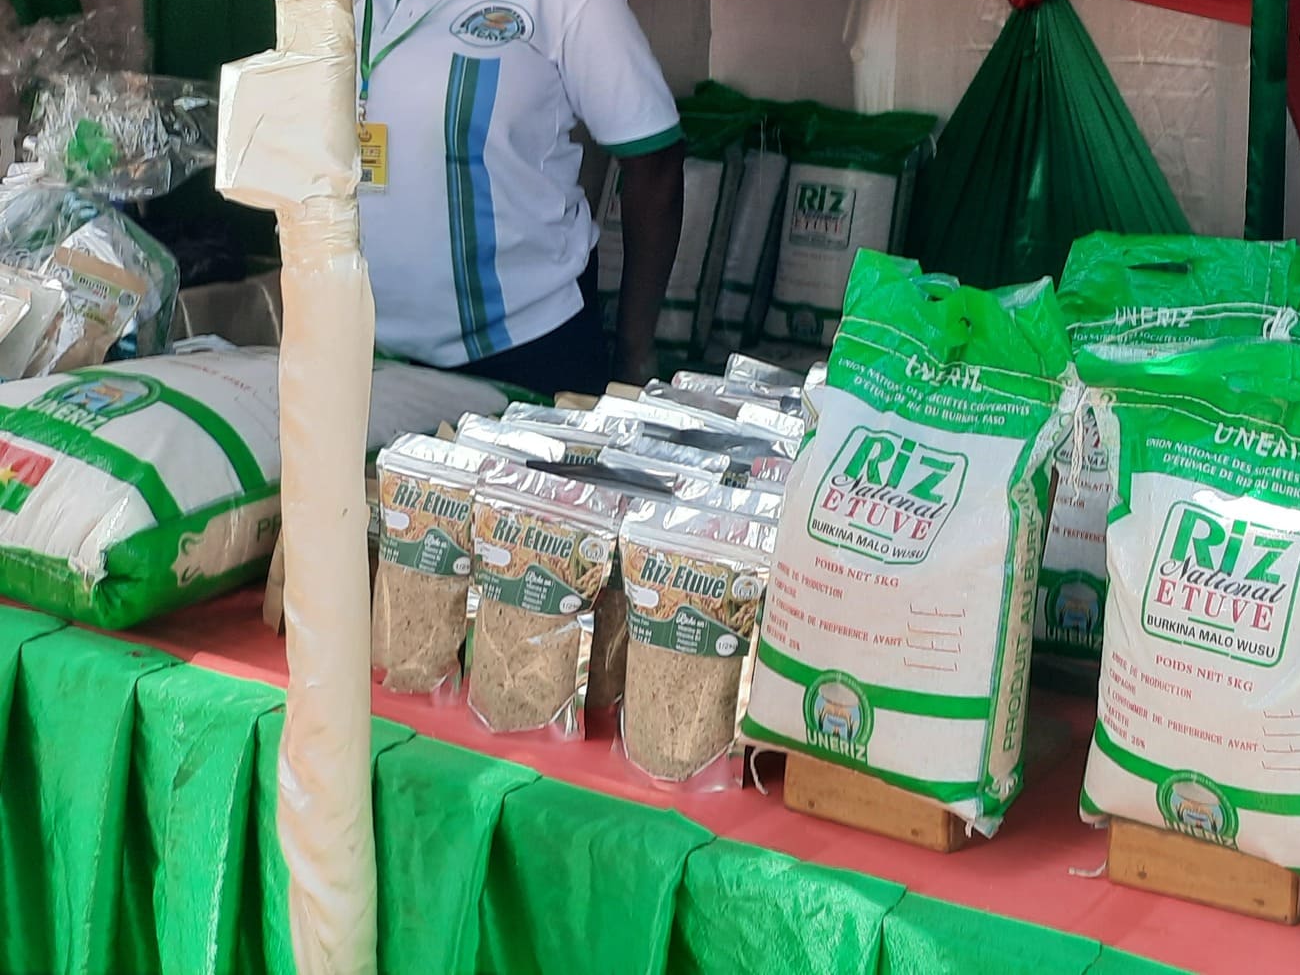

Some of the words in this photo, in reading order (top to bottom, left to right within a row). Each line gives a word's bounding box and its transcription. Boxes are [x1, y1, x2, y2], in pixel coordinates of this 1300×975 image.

[843, 435, 955, 503] Riz
[1146, 438, 1172, 450] UNION
[1231, 459, 1250, 473] DES
[1219, 468, 1233, 481] DE
[392, 482, 422, 509] Riz
[422, 491, 471, 522] Etuvé
[821, 487, 932, 541] ETUVE
[831, 474, 947, 523] National
[492, 516, 521, 545] Riz
[523, 526, 575, 558] Etuvé
[812, 519, 854, 543] BURKINA
[857, 533, 889, 554] MALO
[892, 543, 924, 559] WUSU
[1169, 508, 1296, 585] Riz
[641, 557, 672, 588] Riz
[672, 565, 728, 599] Etuvé
[815, 556, 844, 575] POIDS
[847, 568, 871, 582] NET
[1159, 556, 1288, 605] National
[1153, 578, 1275, 632] ETUVE
[1146, 613, 1197, 640] BURKINA
[1199, 628, 1234, 649] MALO
[1236, 638, 1276, 659] WUSU
[1003, 633, 1029, 753] PRODUIT
[1155, 654, 1193, 674] POIDS
[1196, 667, 1224, 683] NET
[1226, 675, 1254, 693] 5KG
[805, 728, 867, 762] UNERIZ
[1227, 738, 1258, 753] AVANT
